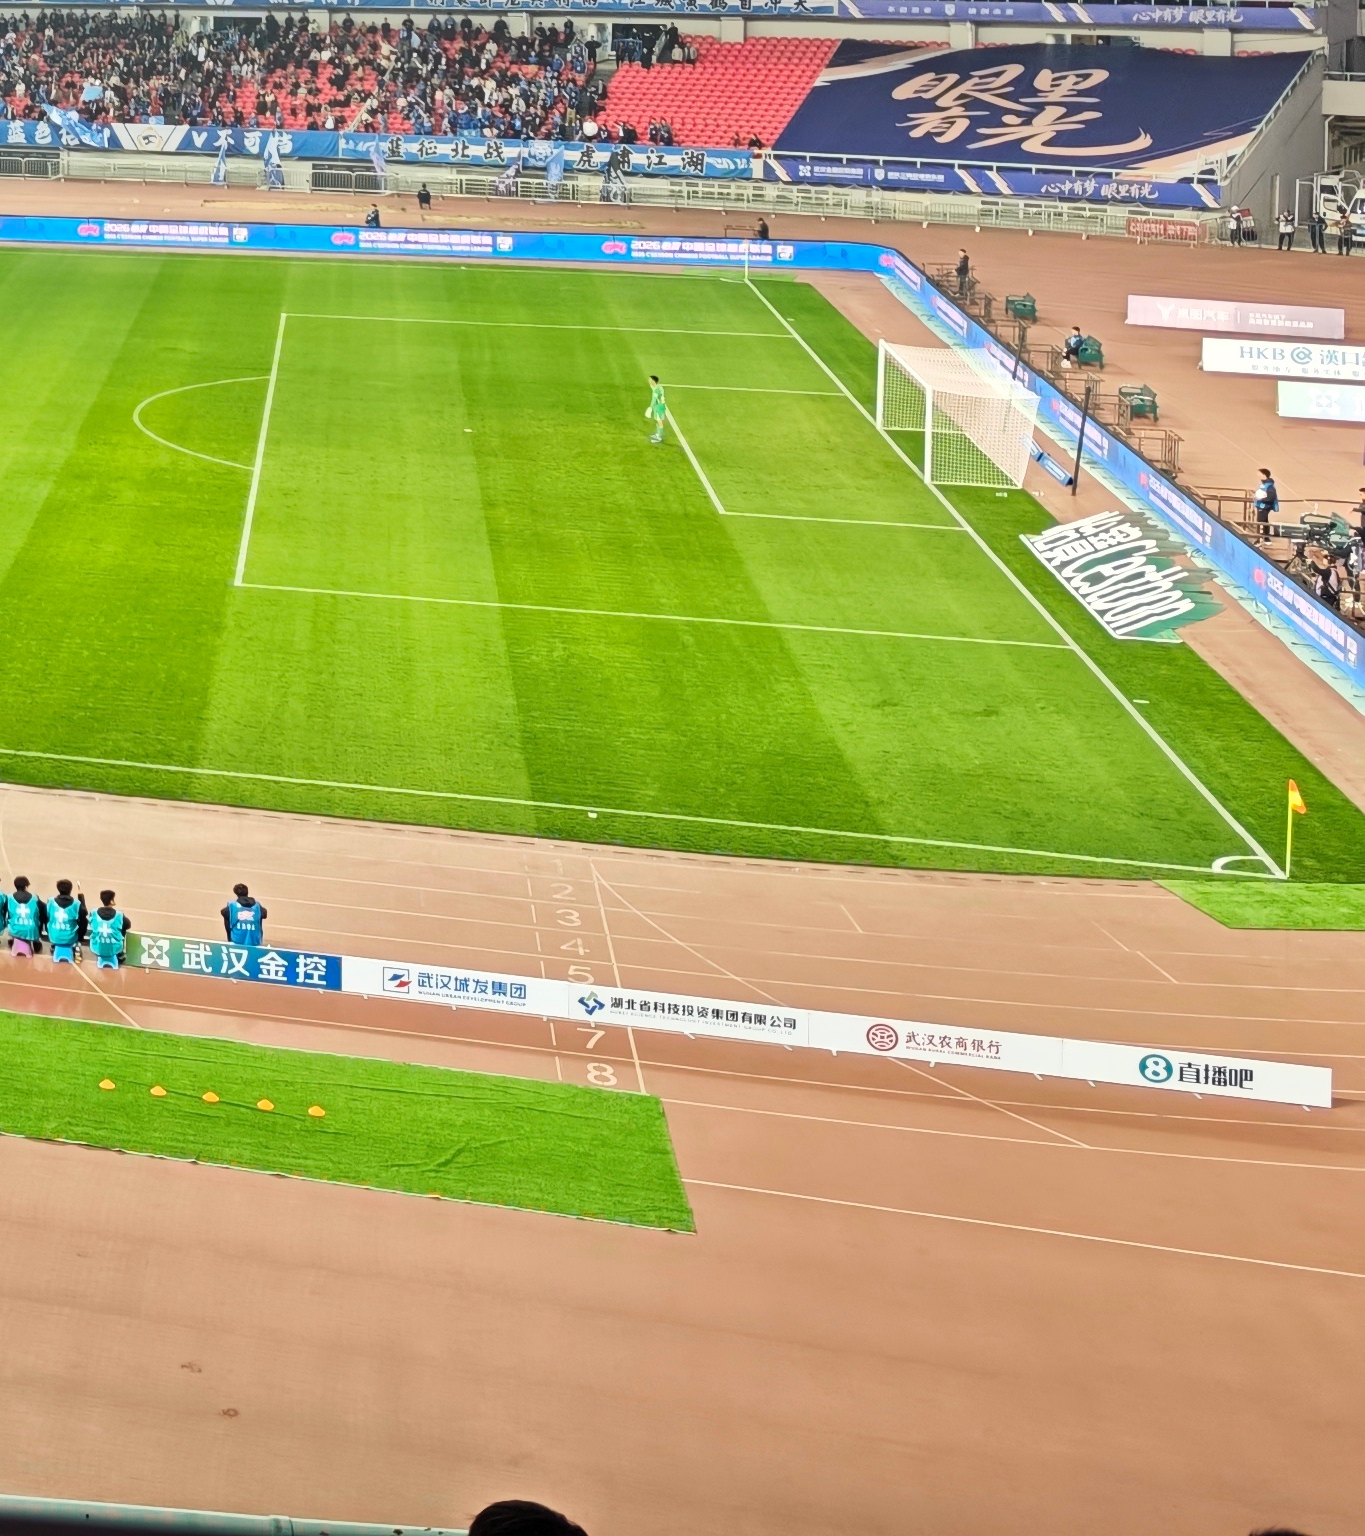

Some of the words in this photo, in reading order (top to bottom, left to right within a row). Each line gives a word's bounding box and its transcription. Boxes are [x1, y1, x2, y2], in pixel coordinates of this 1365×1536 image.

[892, 64, 1110, 112] 眼里
[895, 106, 1153, 156] 有光
[1041, 181, 1098, 198] 心中有梦
[1101, 183, 1159, 199] 眼里有光
[1239, 346, 1286, 360] HKB
[550, 883, 576, 901] 2
[556, 909, 581, 927] 3
[560, 938, 590, 956] 4
[182, 942, 327, 986] 武汉金控
[567, 965, 595, 985] 5
[417, 972, 527, 1001] 武汉城发集团
[610, 995, 797, 1031] 湖北省科技投资集团有限公司
[577, 1028, 605, 1049] 7
[905, 1031, 1003, 1056] 武汉农商银行
[586, 1063, 618, 1086] 8
[1178, 1063, 1254, 1090] 直播吧
